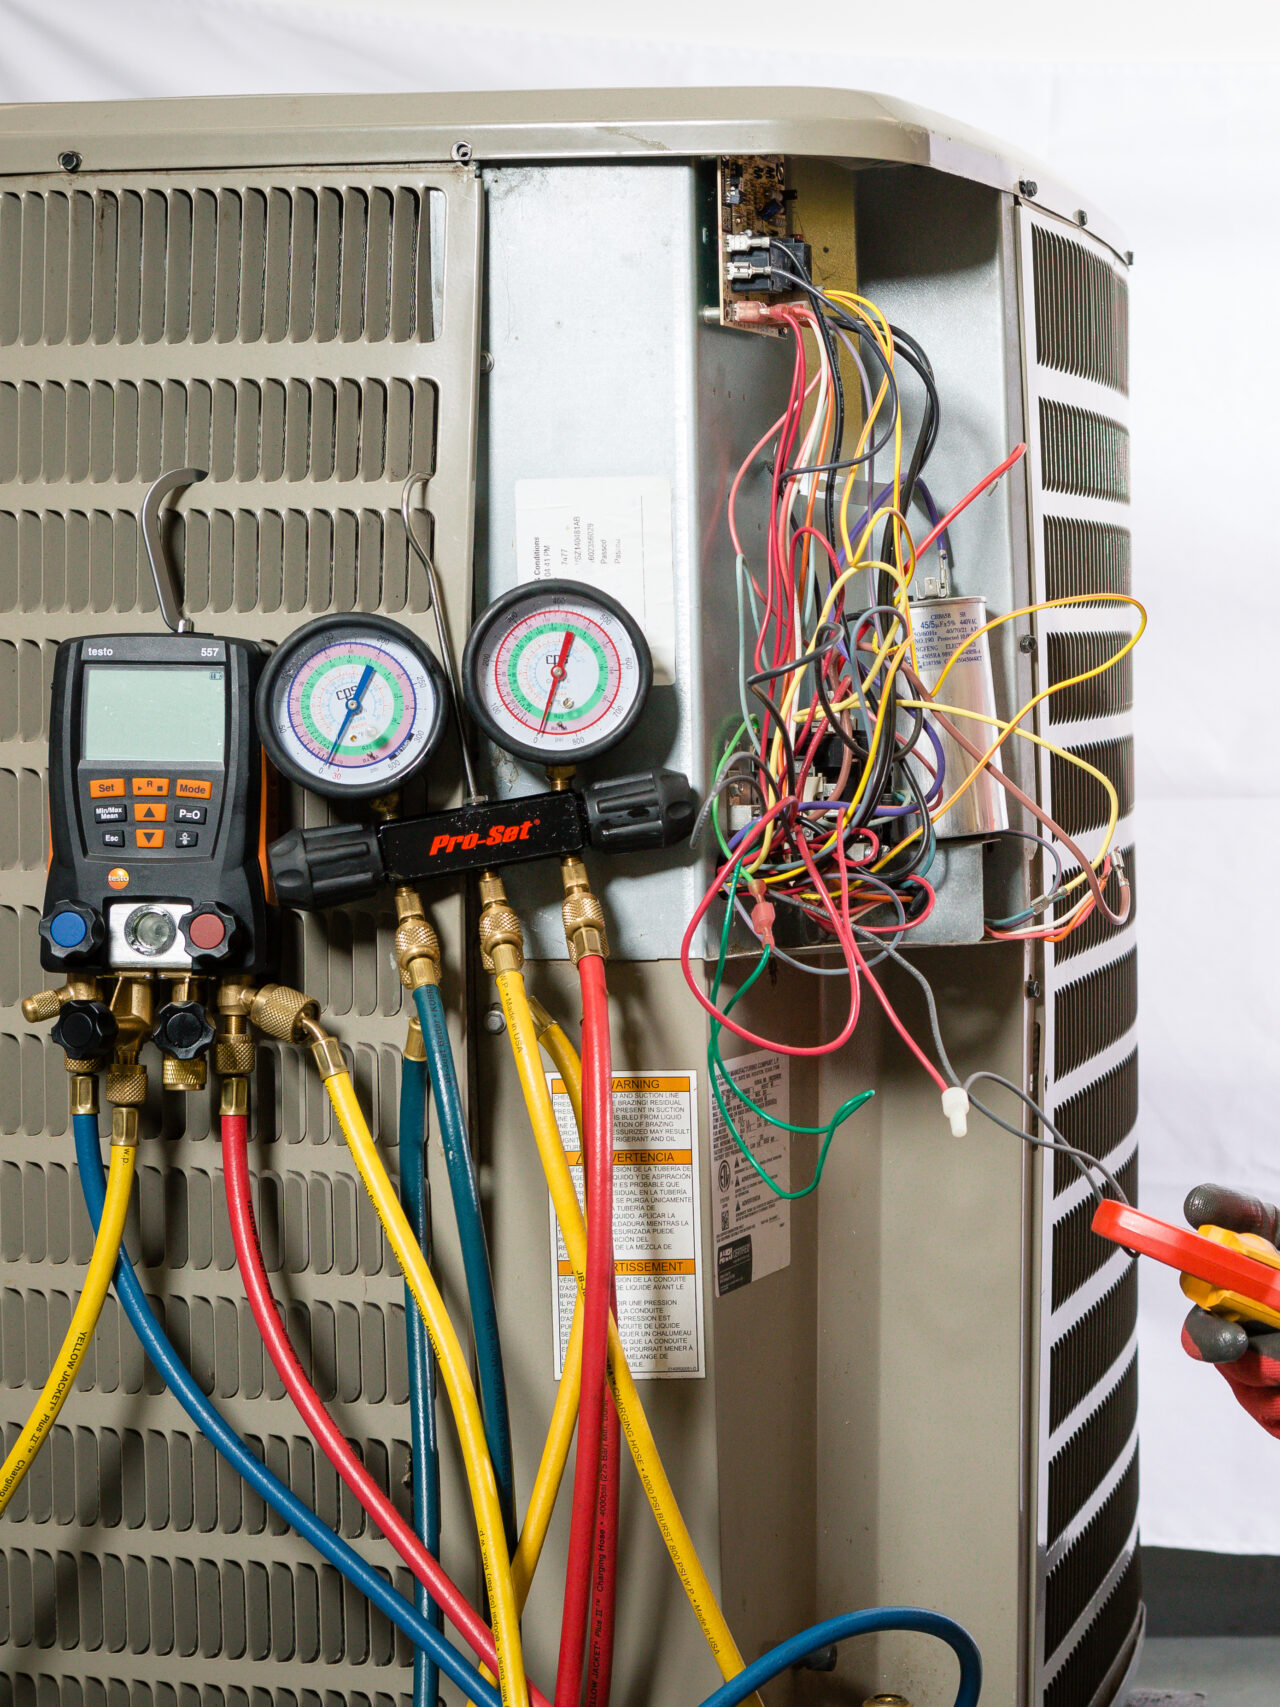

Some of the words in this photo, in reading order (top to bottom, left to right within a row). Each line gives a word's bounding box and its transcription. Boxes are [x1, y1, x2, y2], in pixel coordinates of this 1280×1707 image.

[600, 614, 611, 625] 500
[88, 646, 113, 657] testo
[201, 647, 219, 657] 557
[612, 706, 624, 718] 700
[279, 723, 288, 734] 50
[387, 760, 401, 771] 500
[332, 772, 342, 780] 30
[98, 784, 115, 793] Set
[146, 780, 153, 788] R
[179, 784, 206, 794] Mode
[504, 998, 515, 1021] Made
[513, 1032, 524, 1054] USA
[612, 1152, 675, 1162] ERTENCIA
[613, 1261, 684, 1272] RTISSEMENT
[67, 1331, 88, 1369] YELLOW
[51, 1371, 72, 1407] JACKET
[37, 1413, 51, 1433] Plus
[613, 1387, 634, 1438] CHARGING
[630, 1439, 644, 1466] HOSE
[642, 1473, 655, 1495] 4000
[650, 1495, 660, 1513] PSI
[656, 1512, 674, 1542] BURST
[668, 1544, 681, 1562] 800
[677, 1561, 687, 1577] PSI
[694, 1604, 707, 1628] Made
[707, 1636, 720, 1656] USA
[597, 1529, 606, 1552] Hose
[596, 1552, 606, 1593] Charging
[594, 1620, 602, 1638] Plus
[591, 1644, 601, 1679] JACKET
[588, 1680, 598, 1707] ELLOW
